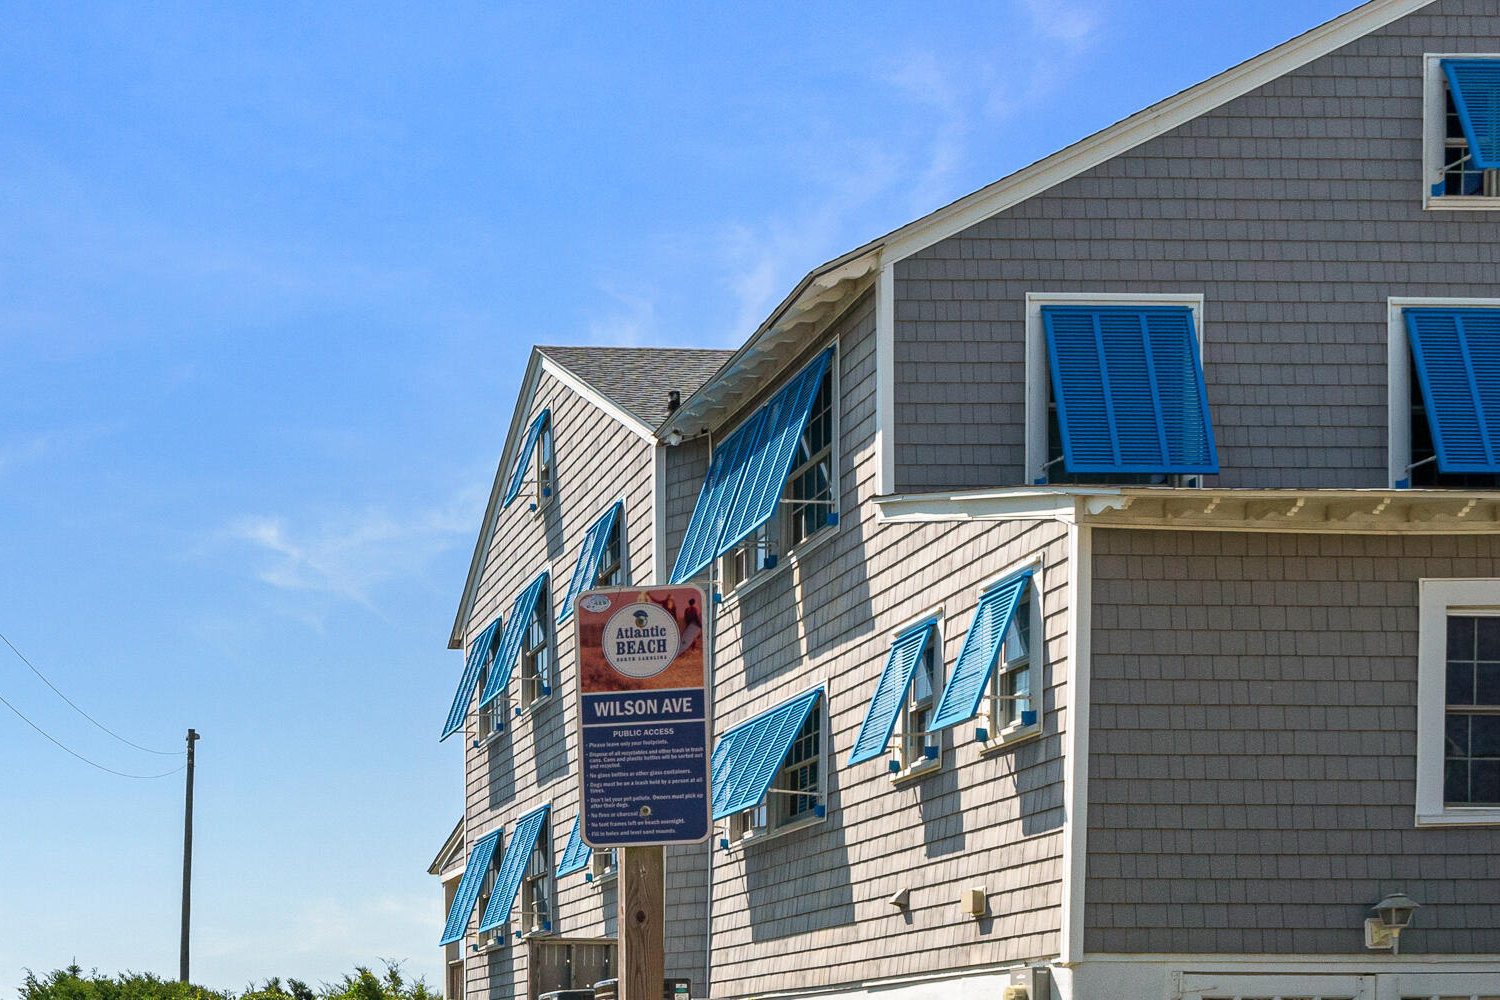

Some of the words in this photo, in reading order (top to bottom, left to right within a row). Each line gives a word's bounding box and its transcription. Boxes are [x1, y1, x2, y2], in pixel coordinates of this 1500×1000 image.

[616, 626, 666, 640] Atlantic
[616, 638, 668, 656] BEACH
[594, 699, 658, 718] WILSON
[662, 697, 692, 714] AVE
[613, 729, 642, 738] PUBLIC
[643, 728, 674, 736] ACCESS
